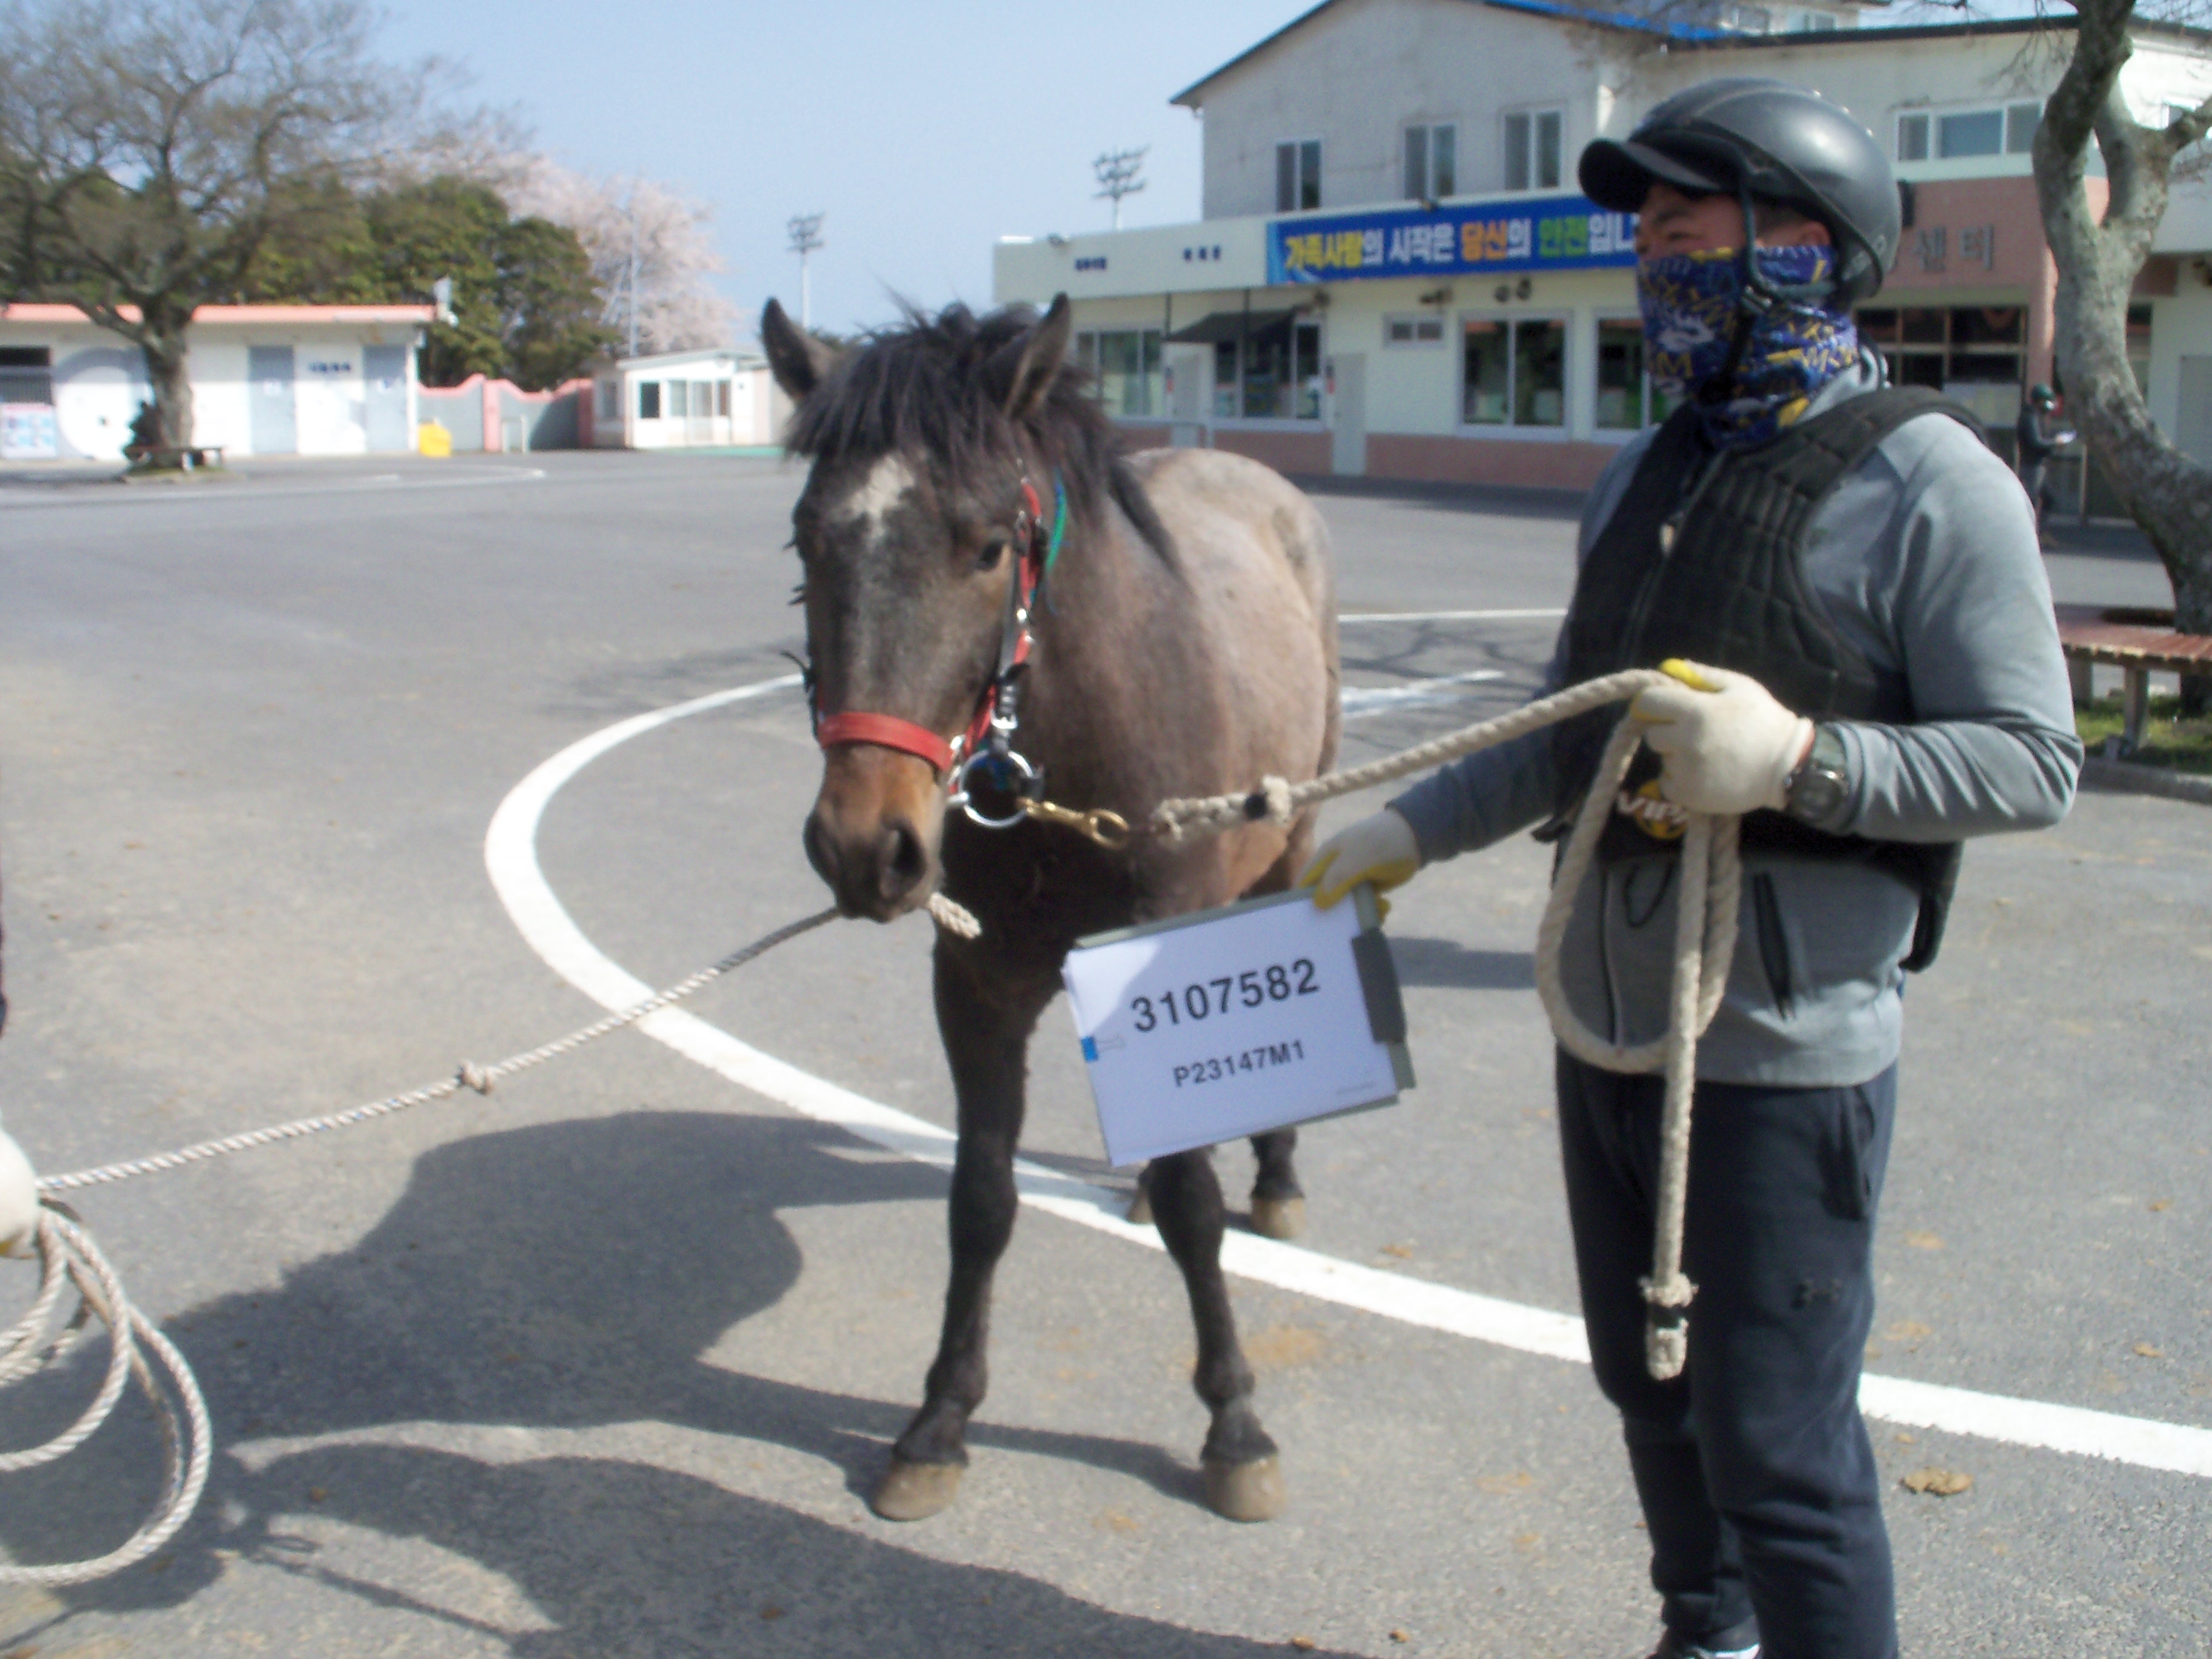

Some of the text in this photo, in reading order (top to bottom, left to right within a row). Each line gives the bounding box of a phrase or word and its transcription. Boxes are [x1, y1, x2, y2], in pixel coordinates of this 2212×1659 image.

[1284, 212, 1640, 270] 가족사랑의 시작은 당신의 안전입니
[1914, 224, 1995, 272] 센터
[1131, 958, 1320, 1032] 3107582
[1173, 1040, 1304, 1086] P23147M1
